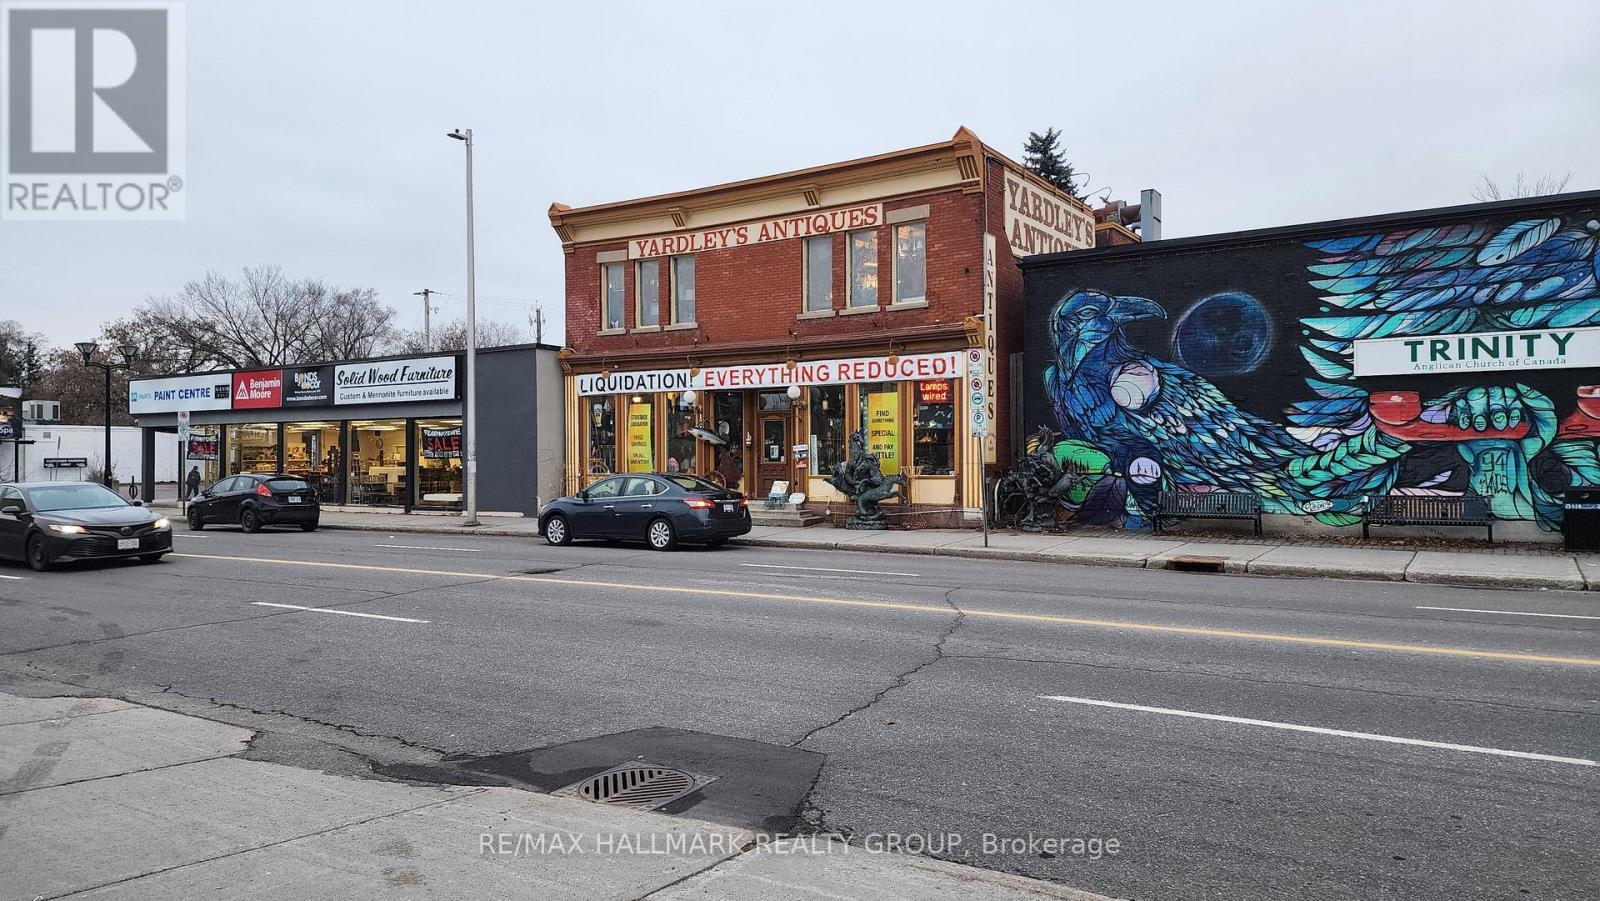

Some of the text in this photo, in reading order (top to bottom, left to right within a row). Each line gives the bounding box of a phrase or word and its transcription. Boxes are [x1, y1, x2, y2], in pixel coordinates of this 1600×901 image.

[1006, 177, 1094, 248] YARDLEY'S
[636, 205, 879, 258] YARDLEY'S ANTIQUES
[986, 248, 994, 420] ANTIQUES
[1404, 332, 1575, 362] TRINITY
[1413, 356, 1567, 371] Anglican Church of Canada
[336, 365, 453, 386] Solid Wood Furniture
[580, 372, 693, 393] LIQUIDATION!
[704, 364, 830, 387] EVERYTHING
[838, 356, 956, 380] REDUCED!
[250, 377, 281, 390] Benjamin
[920, 382, 948, 391] Lamps
[154, 389, 175, 401] PAINT
[178, 387, 211, 400] CENTRE
[250, 389, 272, 399] Moore
[397, 388, 421, 398] furniture
[422, 387, 449, 396] available
[922, 392, 947, 400] wired
[427, 437, 459, 451] SALE
